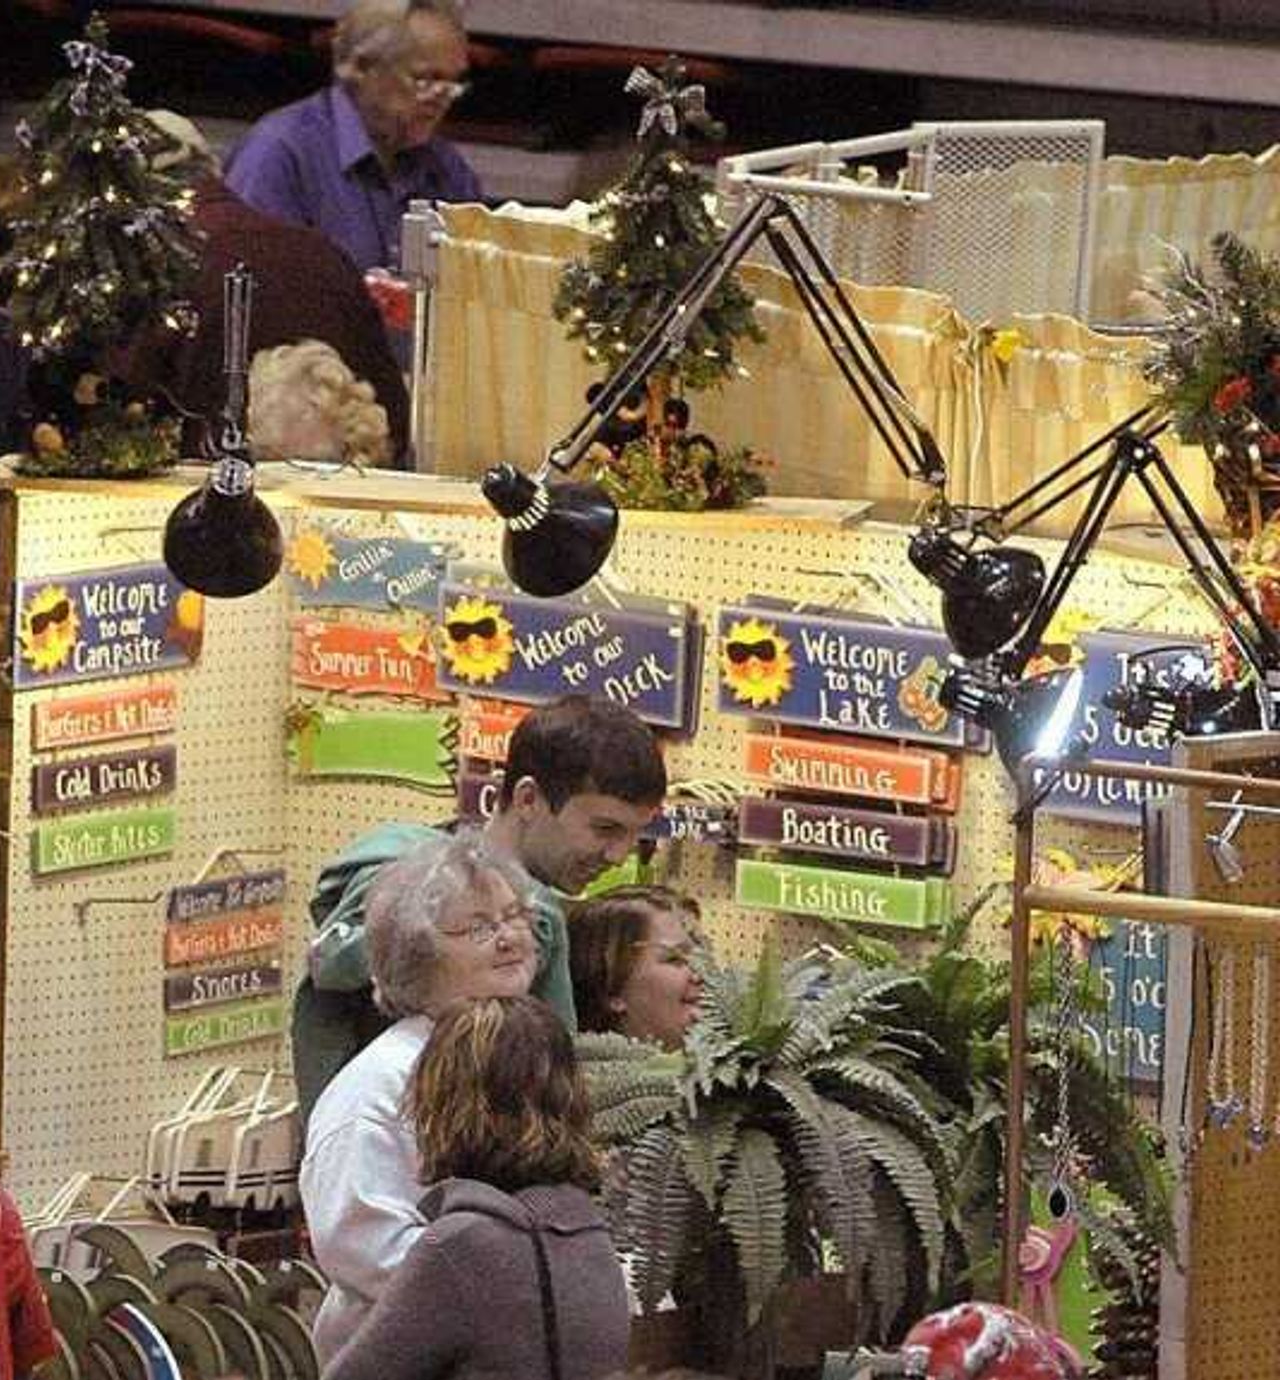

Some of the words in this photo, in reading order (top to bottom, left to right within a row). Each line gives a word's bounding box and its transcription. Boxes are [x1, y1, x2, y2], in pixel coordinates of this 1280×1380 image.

[82, 582, 168, 617] Welcome
[100, 618, 118, 639] to
[121, 618, 146, 638] our
[514, 612, 608, 671] Welcome
[74, 637, 162, 674] Campsite
[561, 660, 589, 686] to
[593, 635, 624, 667] our
[801, 628, 907, 679] Welcome
[824, 669, 848, 692] to
[854, 671, 886, 698] the
[1080, 705, 1100, 744] 5
[55, 766, 93, 801] Cold
[781, 807, 891, 855] Boating
[778, 868, 890, 916] Fishing
